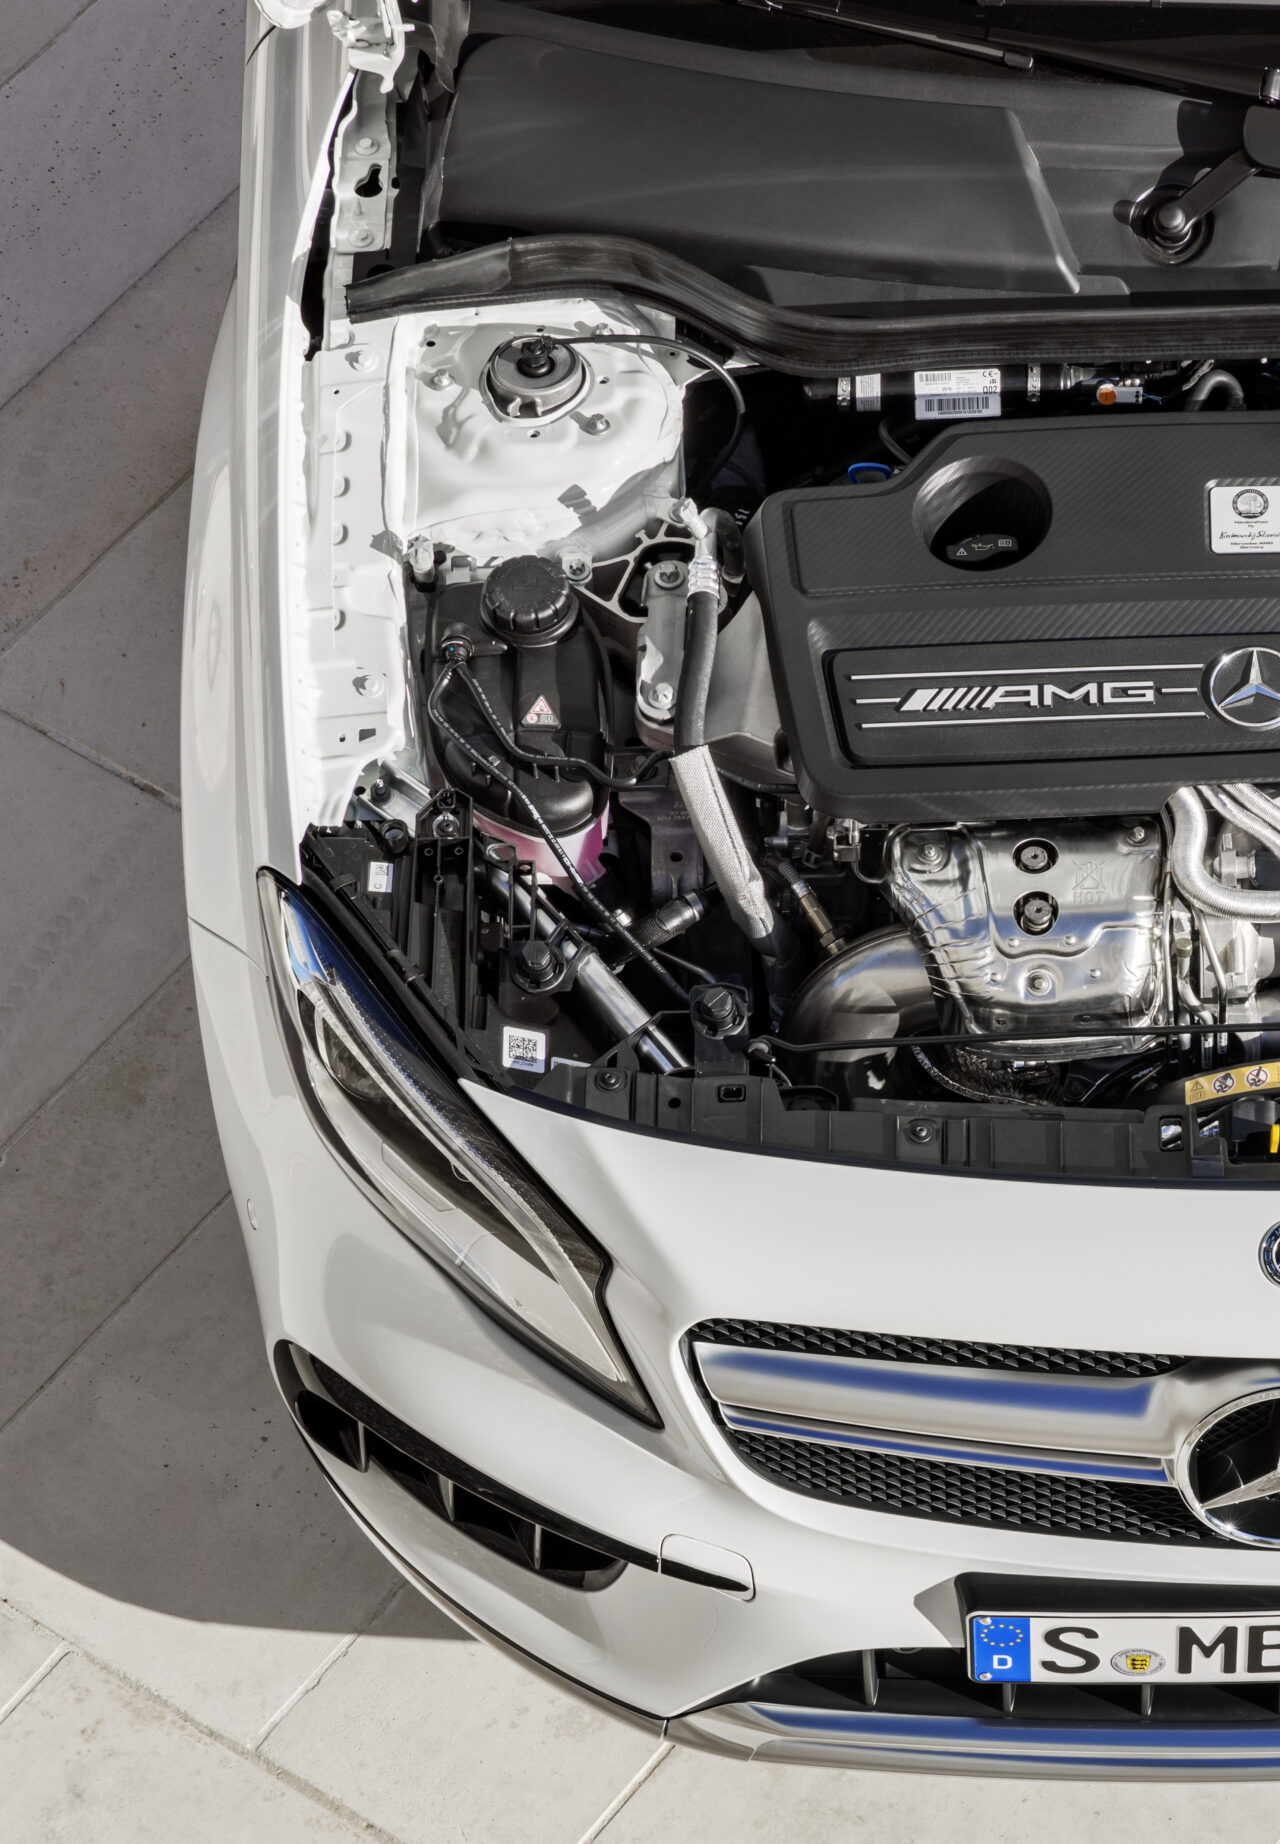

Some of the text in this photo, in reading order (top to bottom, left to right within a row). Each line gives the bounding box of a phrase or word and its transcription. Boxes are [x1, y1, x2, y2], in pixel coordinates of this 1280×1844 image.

[981, 681, 1155, 709] AMG
[1073, 890, 1106, 904] HOT
[1040, 1625, 1101, 1675] S
[992, 1655, 1013, 1669] D
